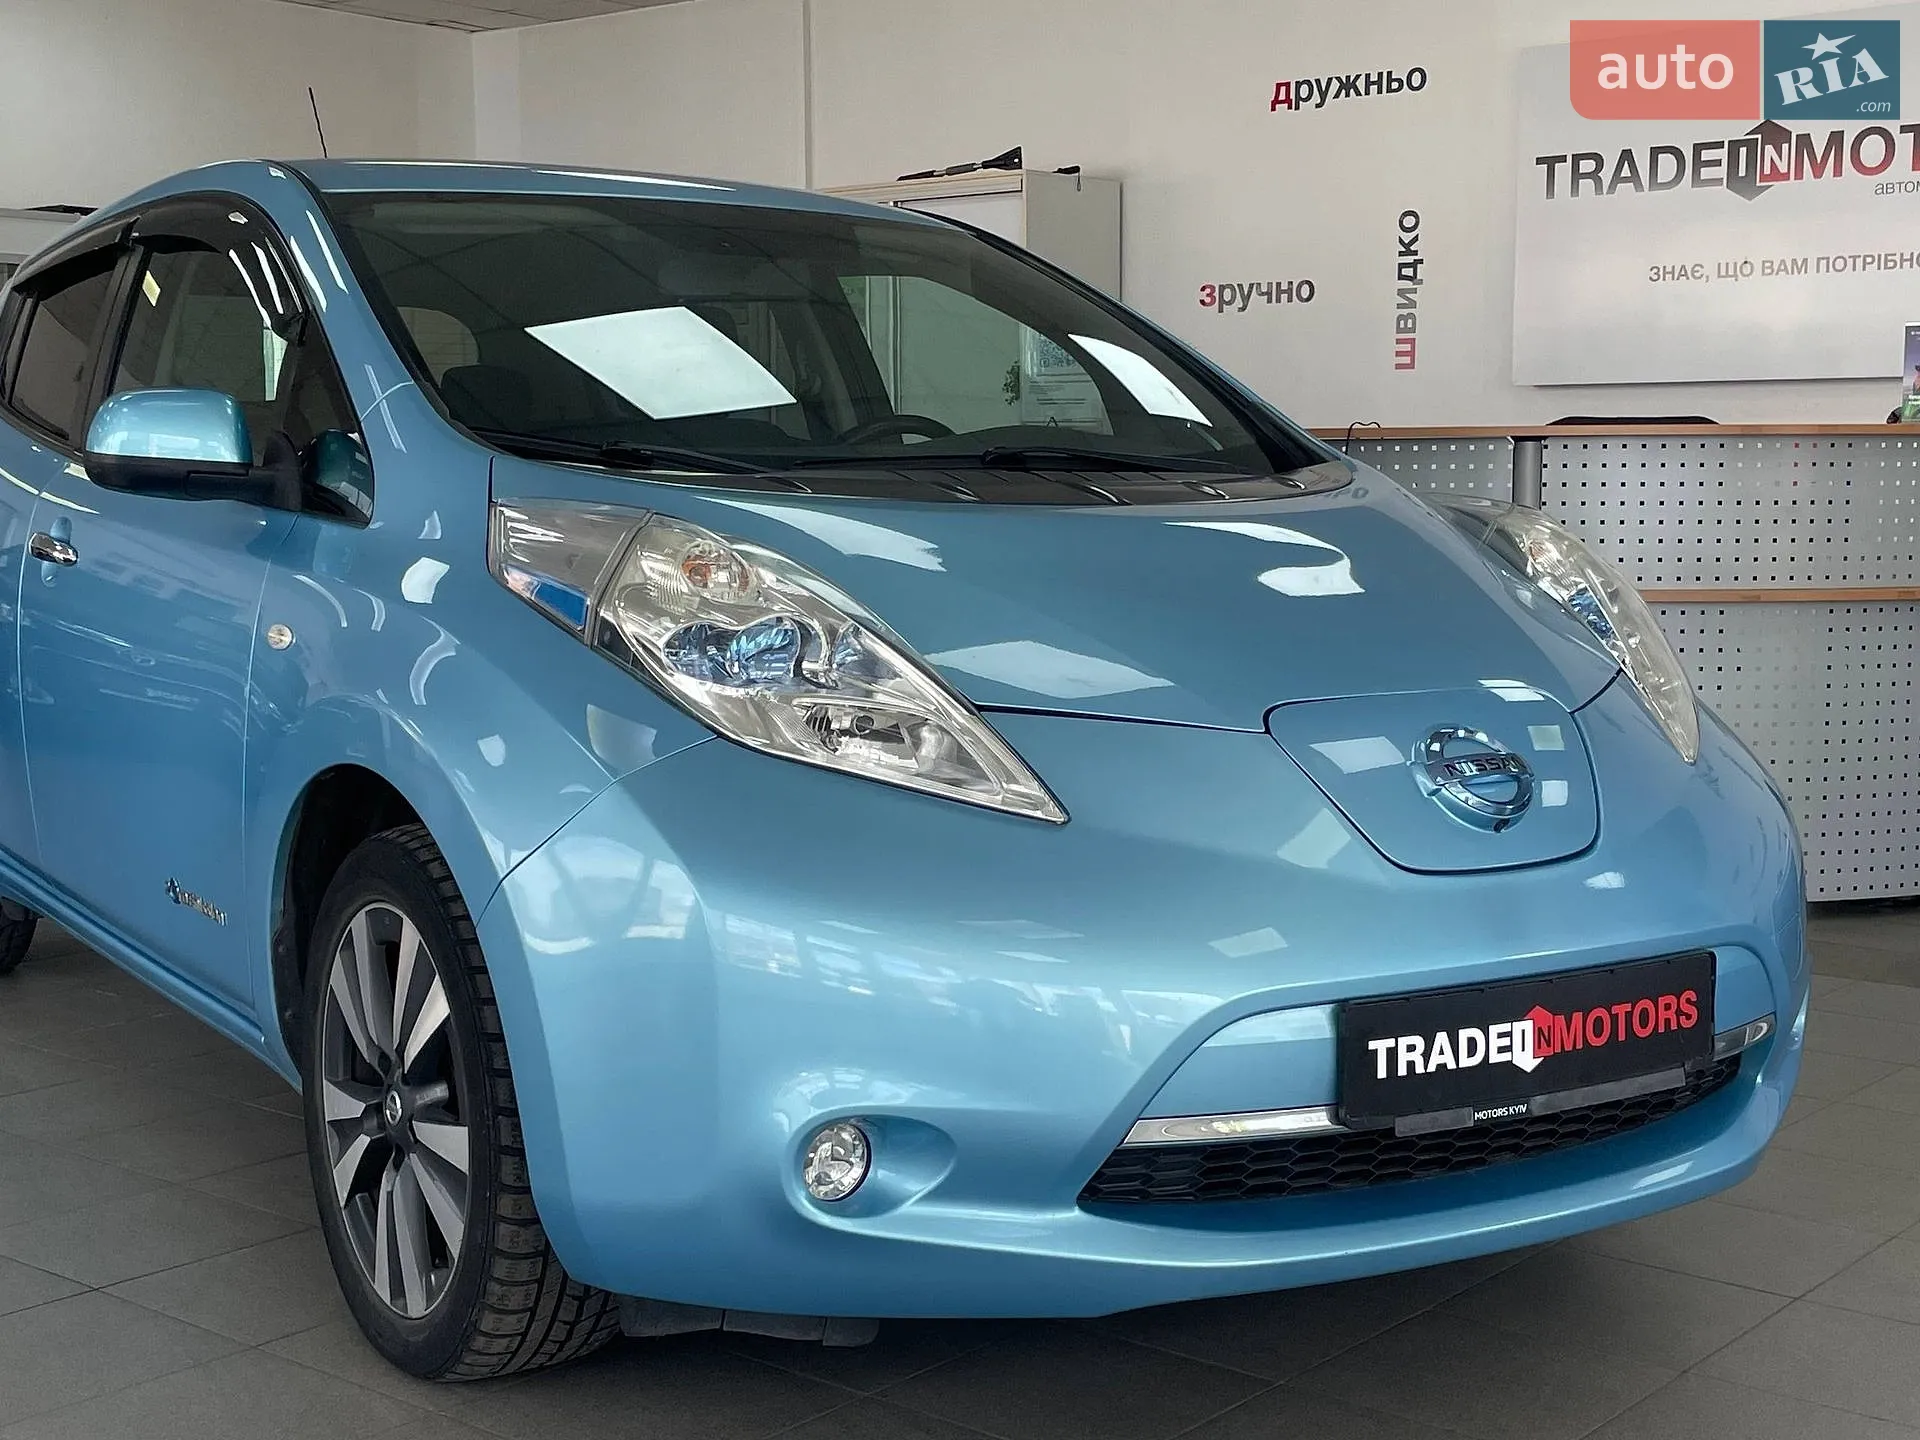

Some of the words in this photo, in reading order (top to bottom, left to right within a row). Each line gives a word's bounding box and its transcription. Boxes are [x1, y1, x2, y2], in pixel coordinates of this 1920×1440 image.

[1270, 66, 1428, 112] дружньо
[1649, 263, 1710, 283] ЗНАЄ,
[1716, 259, 1755, 281] ЩО
[1760, 257, 1809, 277] ВАМ
[1199, 279, 1316, 314] зручно
[1474, 1107, 1508, 1120] MOTORS
[1508, 1103, 1528, 1115] KYIV
